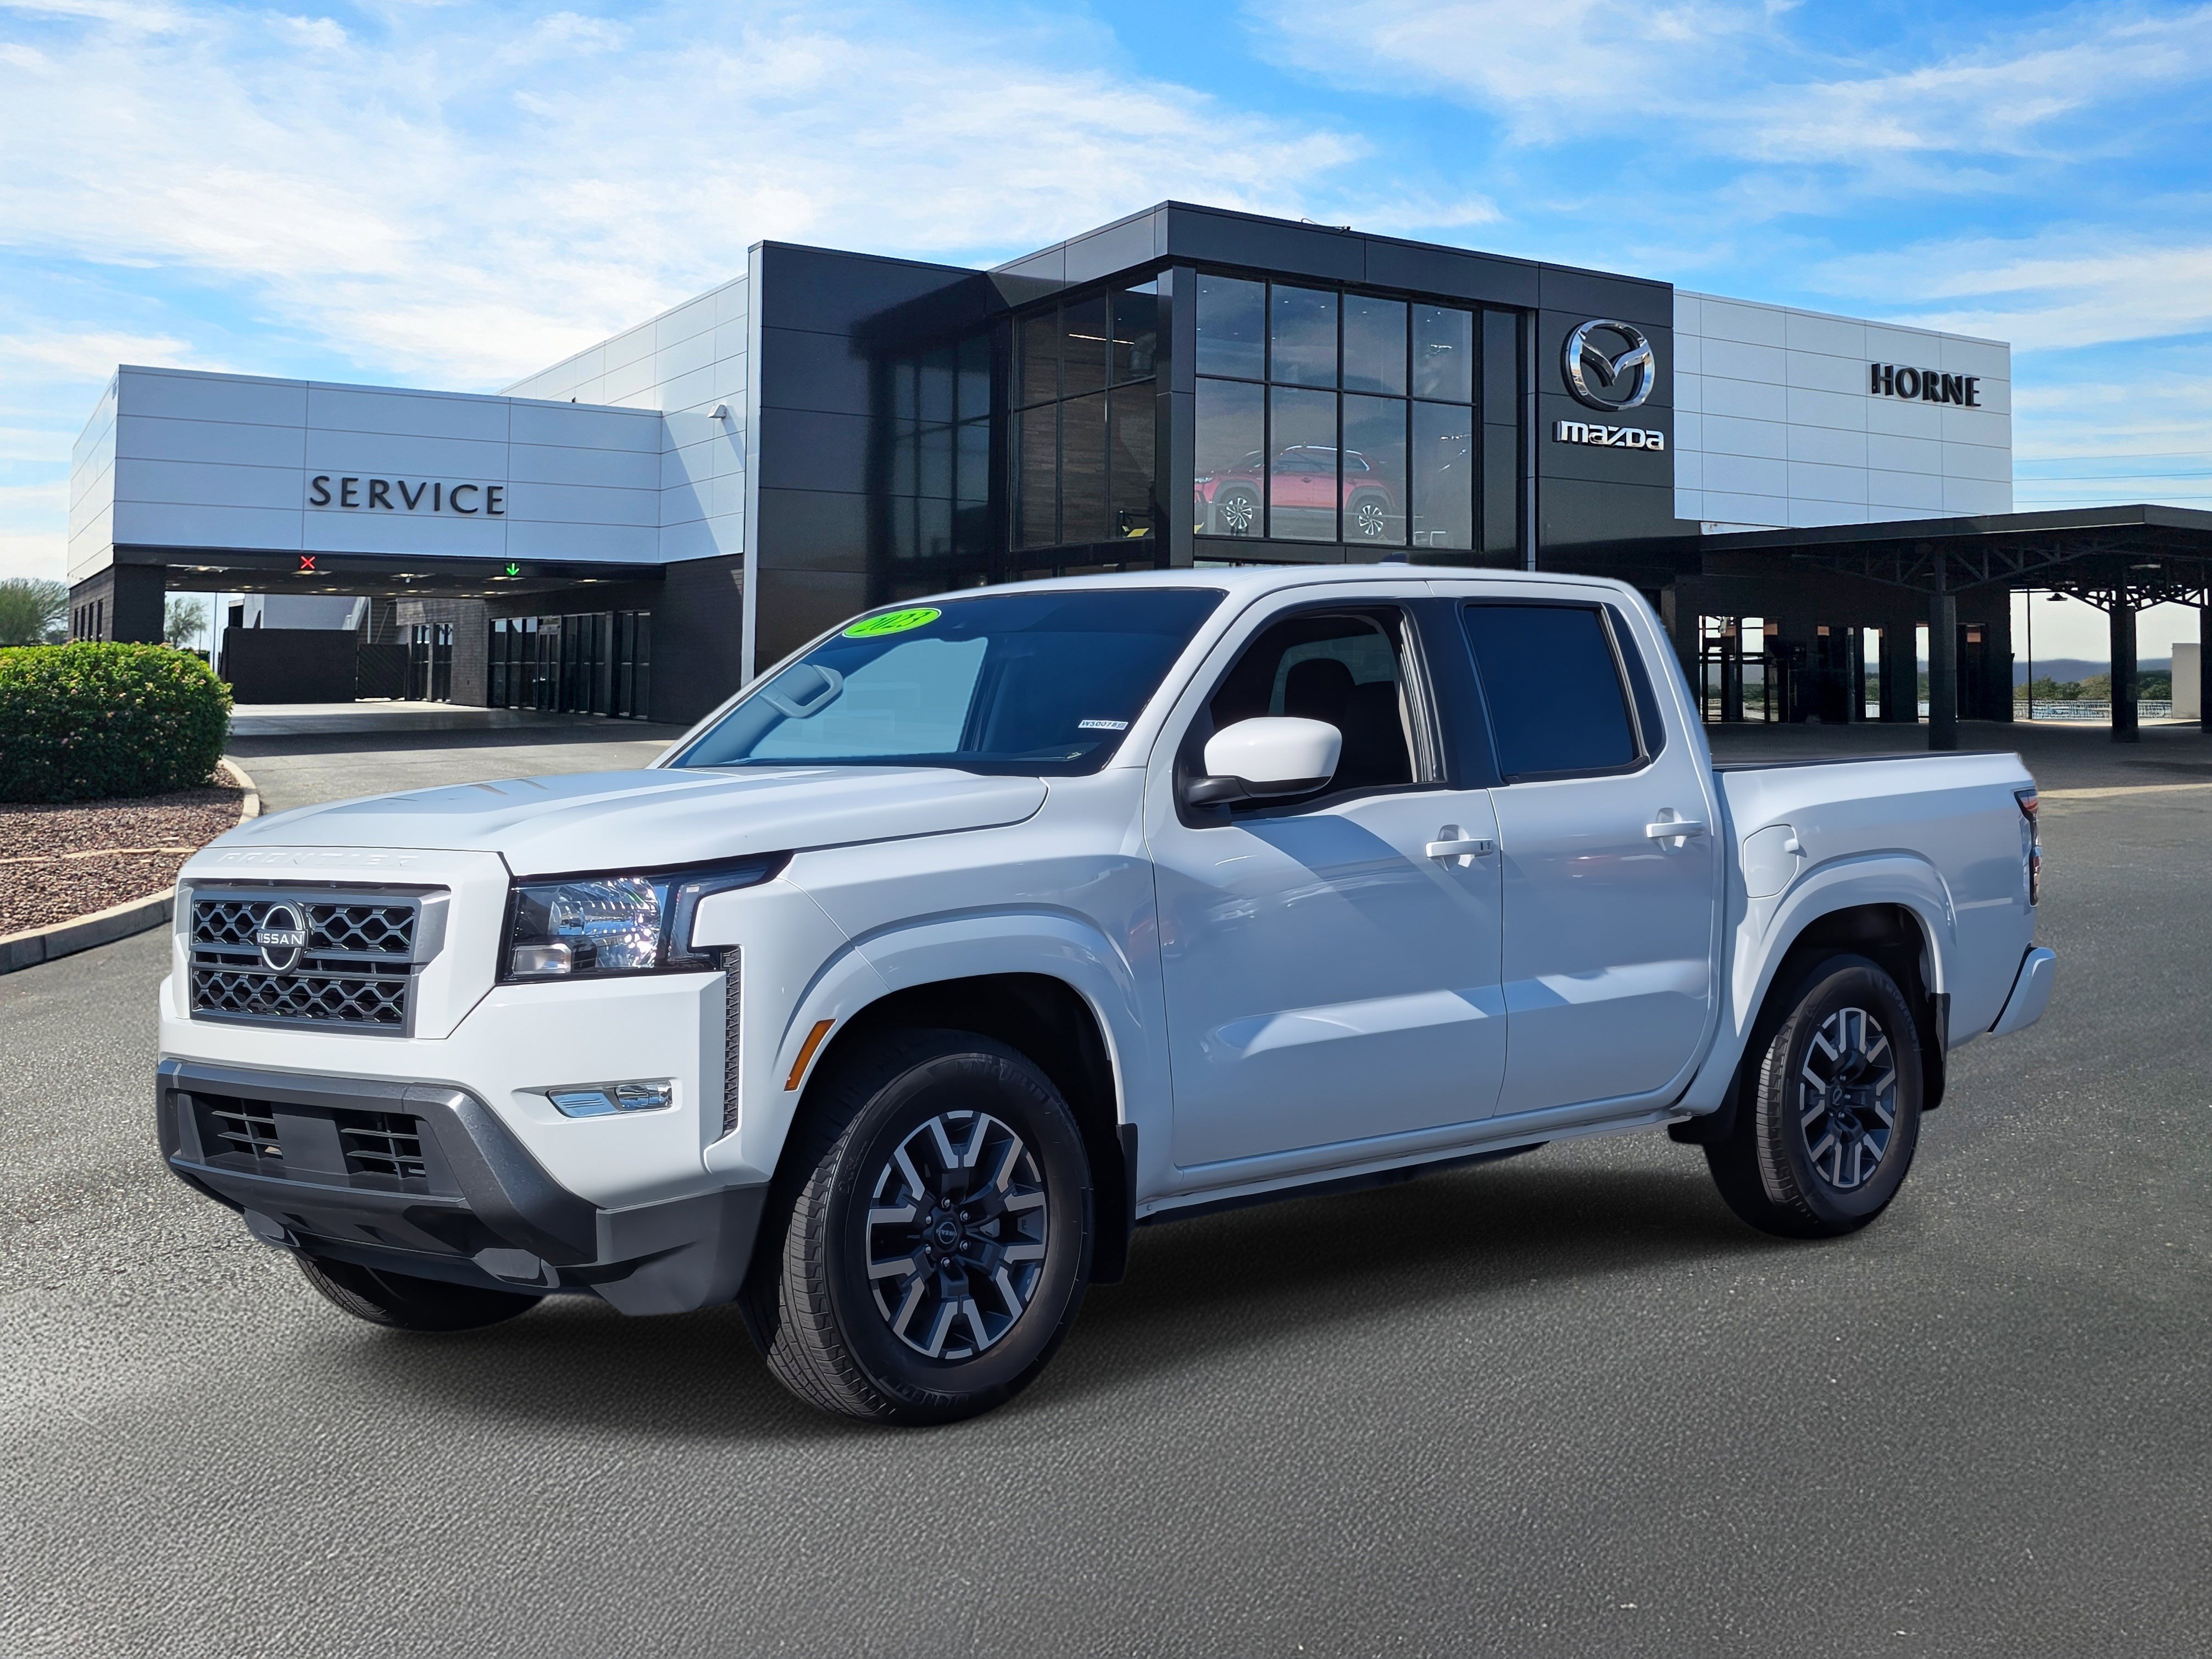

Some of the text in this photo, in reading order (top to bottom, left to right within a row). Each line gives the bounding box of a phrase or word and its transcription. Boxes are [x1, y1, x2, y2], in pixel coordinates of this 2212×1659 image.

[1871, 363, 1982, 407] HORNE
[1554, 420, 1665, 451] mazda
[309, 475, 505, 515] SERVICE
[853, 611, 932, 634] 2023
[257, 933, 302, 945] NISSAN
